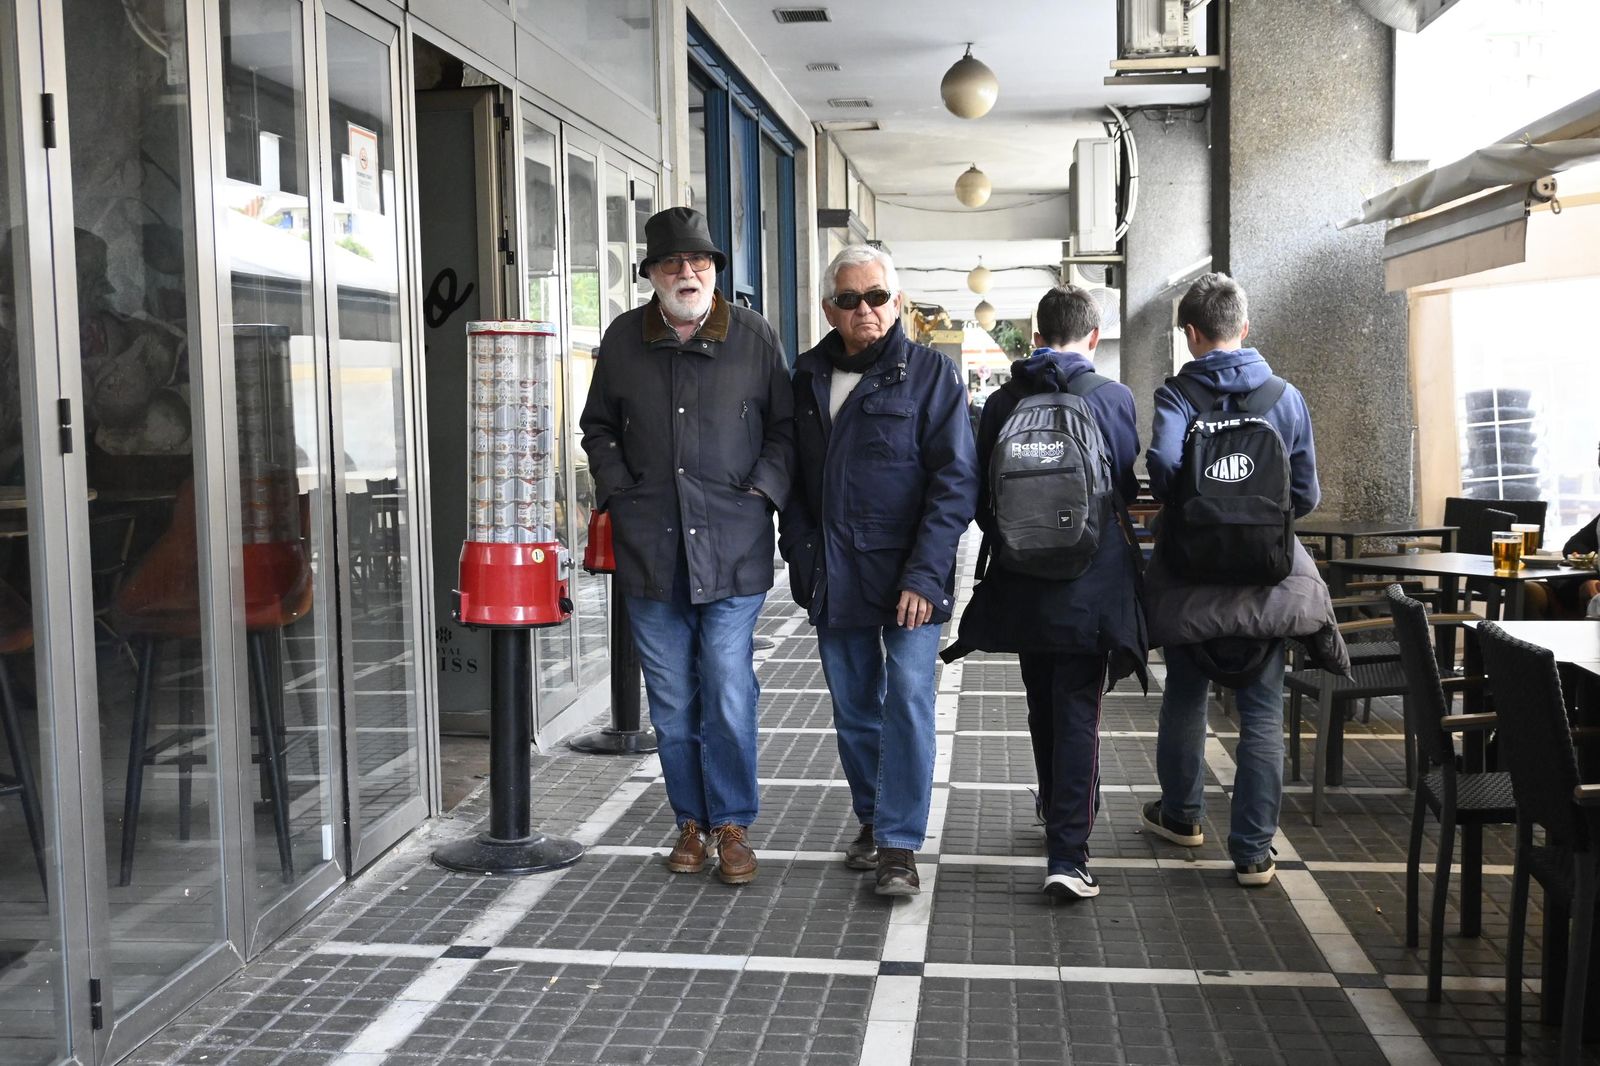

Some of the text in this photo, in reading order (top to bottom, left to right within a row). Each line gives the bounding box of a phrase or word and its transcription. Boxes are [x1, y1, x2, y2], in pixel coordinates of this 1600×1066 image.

[1206, 419, 1240, 433] THE
[1011, 441, 1064, 452] Reebok
[1212, 455, 1248, 480] VANS
[440, 656, 478, 674] ISS
